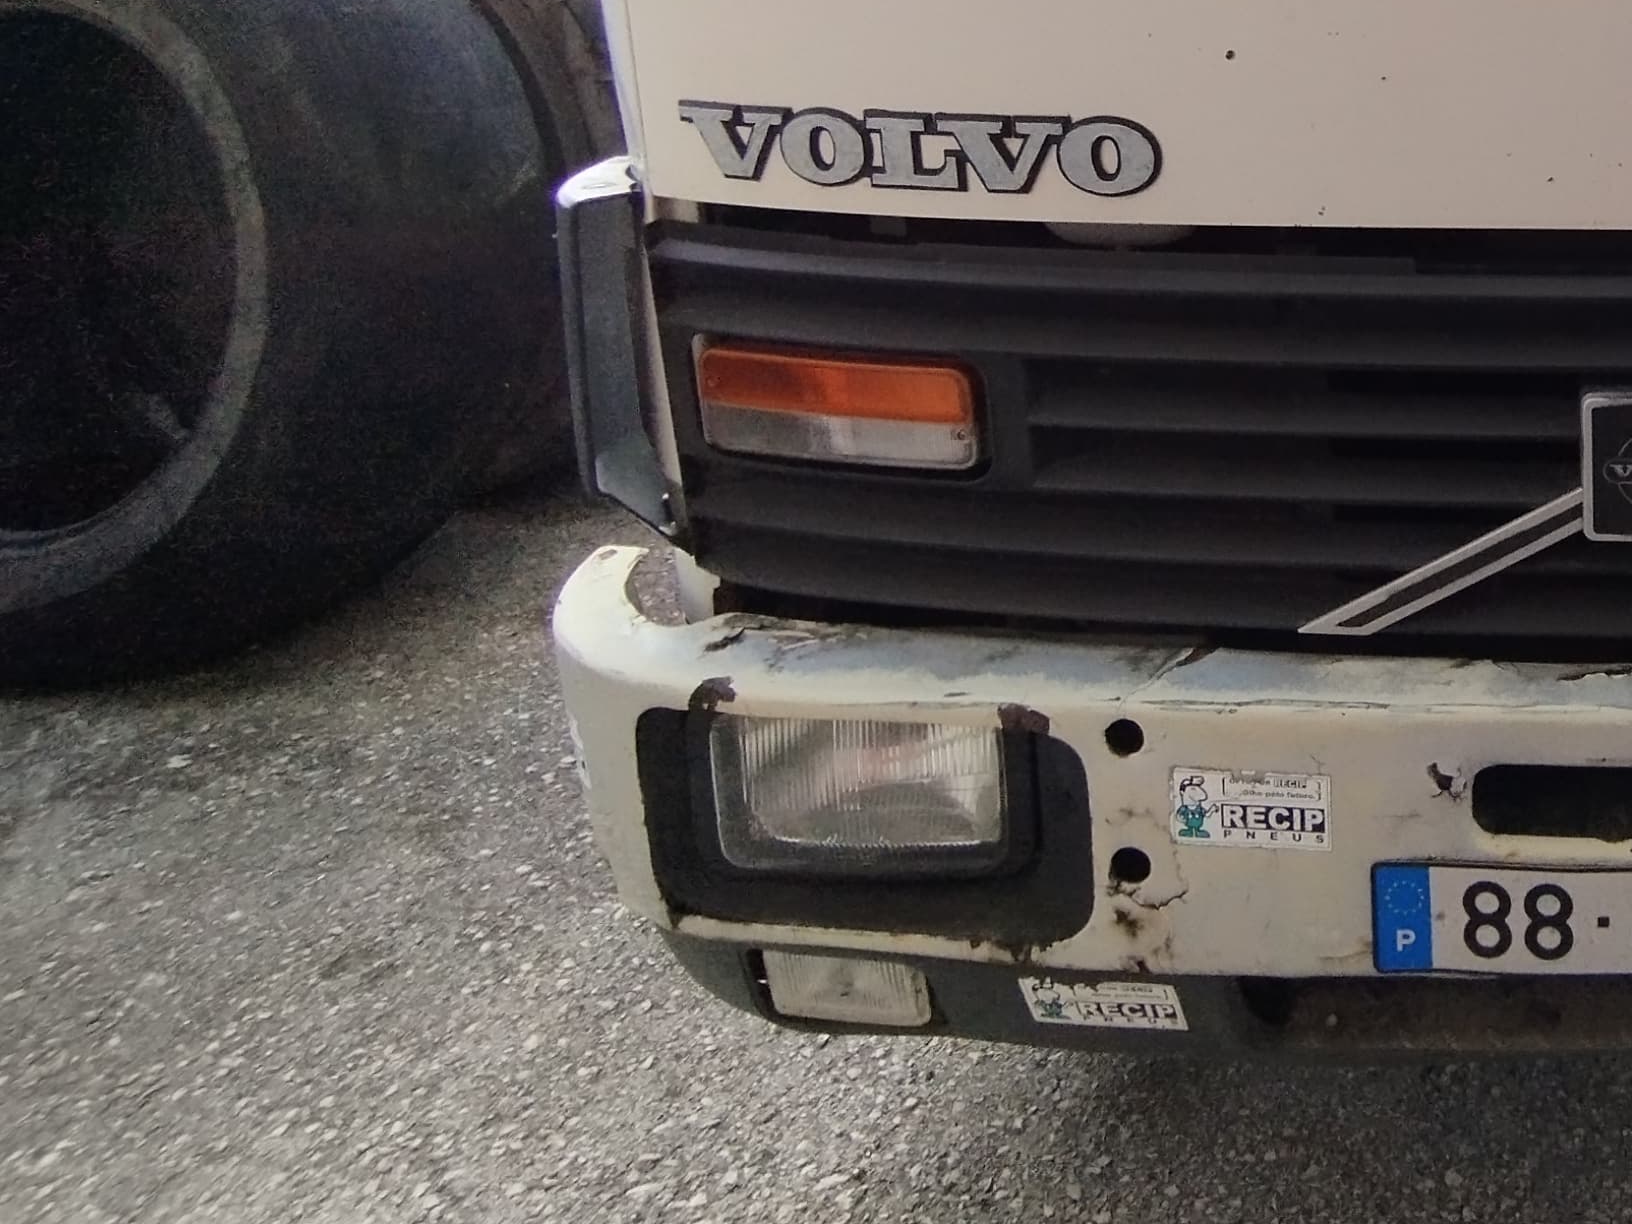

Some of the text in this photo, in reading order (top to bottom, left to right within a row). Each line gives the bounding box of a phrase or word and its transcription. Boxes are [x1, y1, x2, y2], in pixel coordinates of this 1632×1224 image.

[679, 99, 1164, 198] VOLVO
[1221, 803, 1325, 833] RECIP
[1223, 829, 1325, 843] PNEUS
[1396, 929, 1417, 952] P
[1075, 1001, 1179, 1020] RECIP
